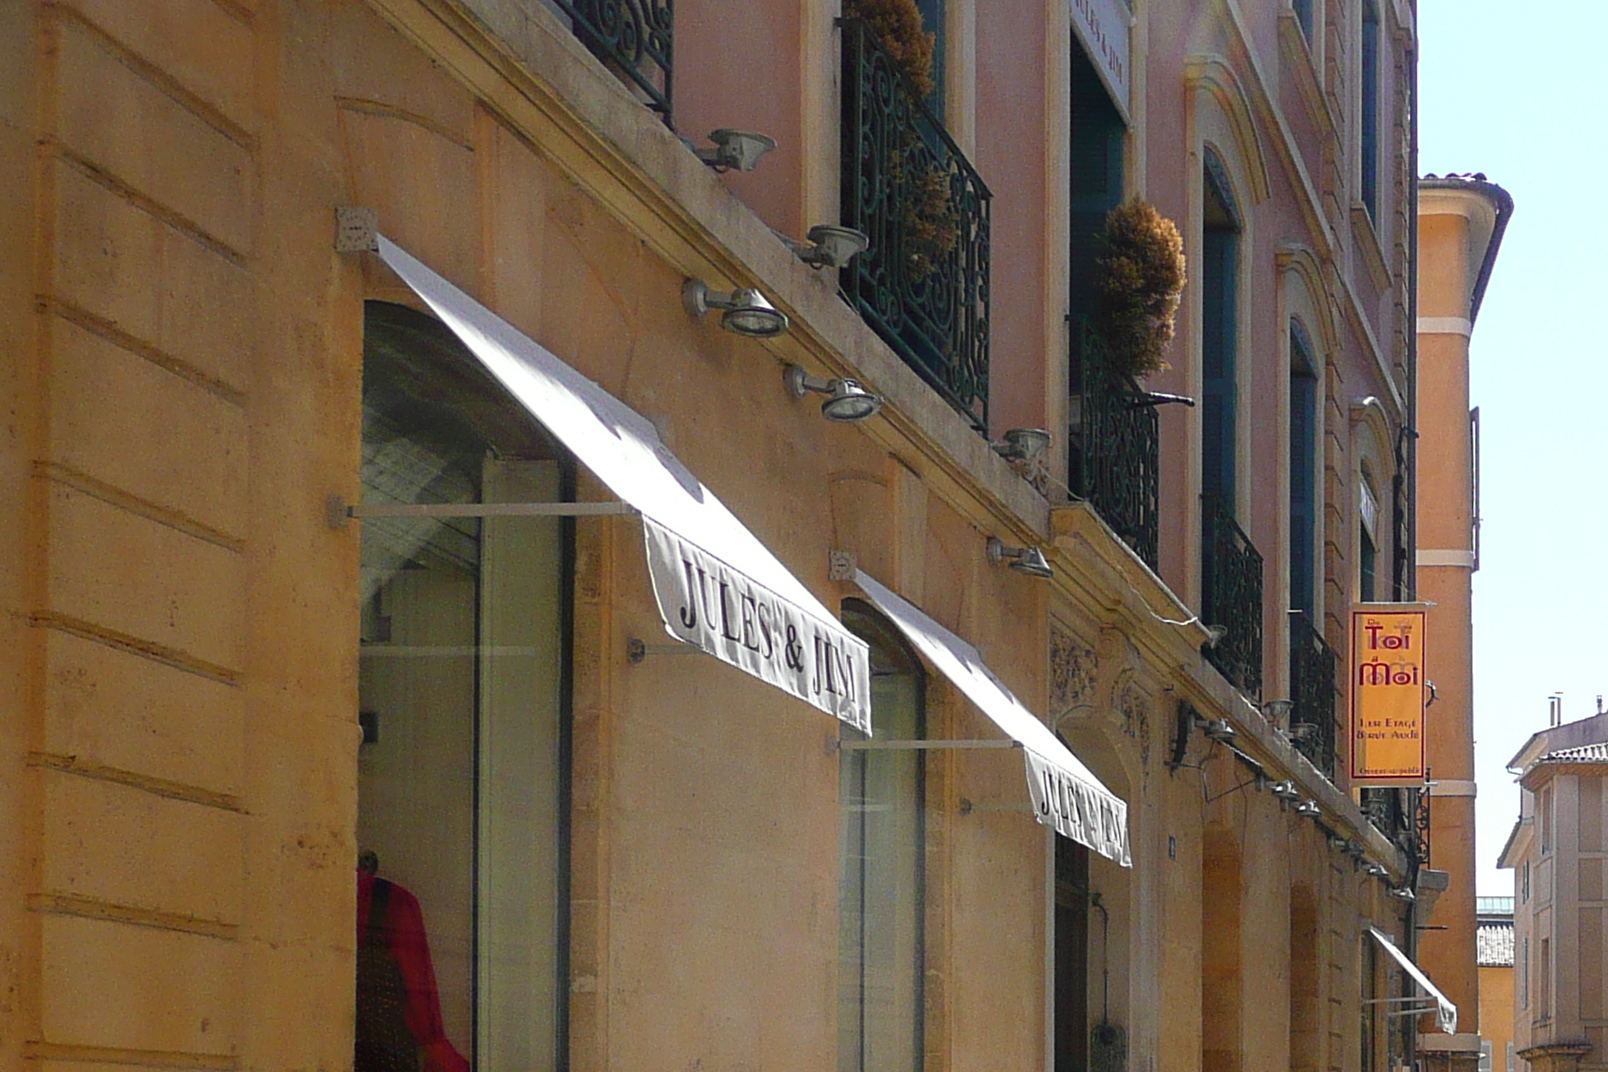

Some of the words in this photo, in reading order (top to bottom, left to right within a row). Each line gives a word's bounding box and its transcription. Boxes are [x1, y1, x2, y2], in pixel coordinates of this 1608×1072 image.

[680, 559, 773, 660] JULES
[785, 624, 804, 673] &
[813, 635, 857, 703] JIM
[1365, 625, 1410, 650] Toi
[1359, 662, 1419, 686] Moi
[1041, 770, 1083, 828] JULES
